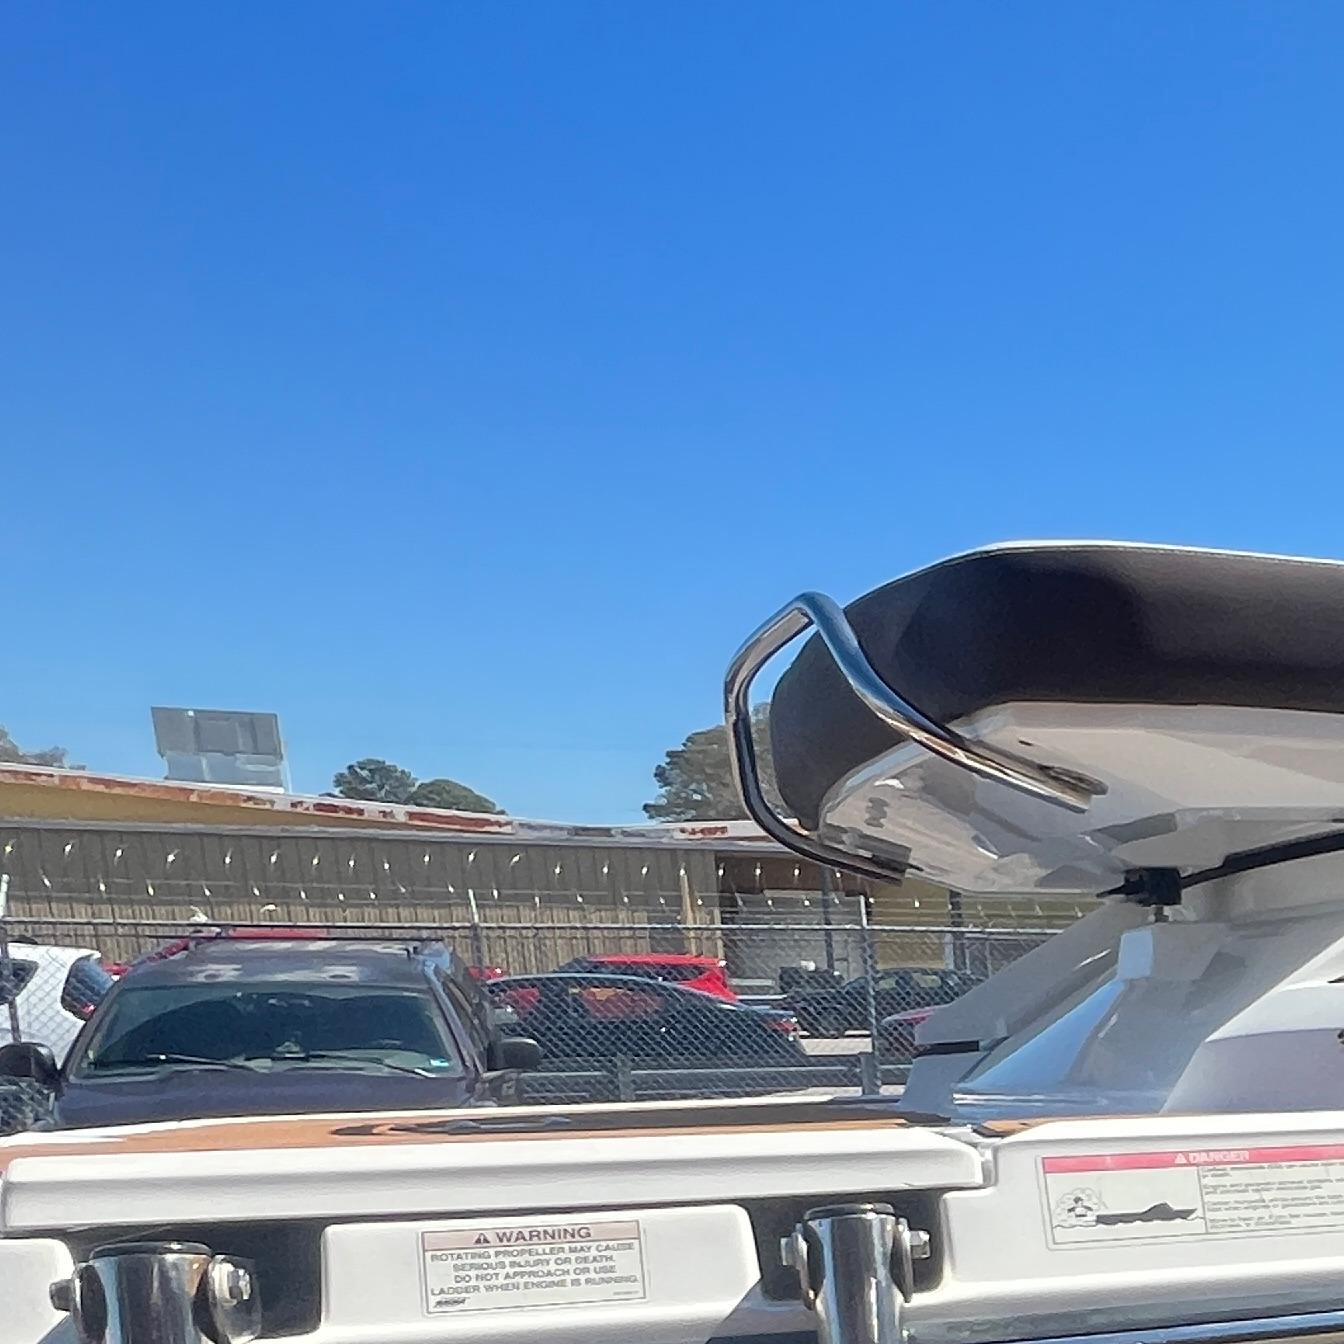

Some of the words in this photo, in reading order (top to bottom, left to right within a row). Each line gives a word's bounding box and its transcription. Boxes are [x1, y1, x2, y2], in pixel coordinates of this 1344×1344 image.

[1188, 1150, 1250, 1164] DANGER
[495, 1226, 593, 1244] WARNING
[430, 1251, 492, 1263] ROTATING
[494, 1246, 566, 1259] PROPELLER
[568, 1244, 593, 1254] MAY
[452, 1260, 507, 1272] SERIOUS
[508, 1258, 551, 1270] INJURY
[554, 1257, 573, 1266] OR
[453, 1274, 473, 1284] DO
[475, 1272, 501, 1283] NOT
[503, 1267, 571, 1281] APPROACH
[573, 1266, 591, 1276] OR
[594, 1264, 618, 1275] USE
[430, 1284, 482, 1297] LADDER
[484, 1281, 521, 1293] WHEN
[524, 1278, 568, 1291] ENGINE
[570, 1277, 582, 1287] IS
